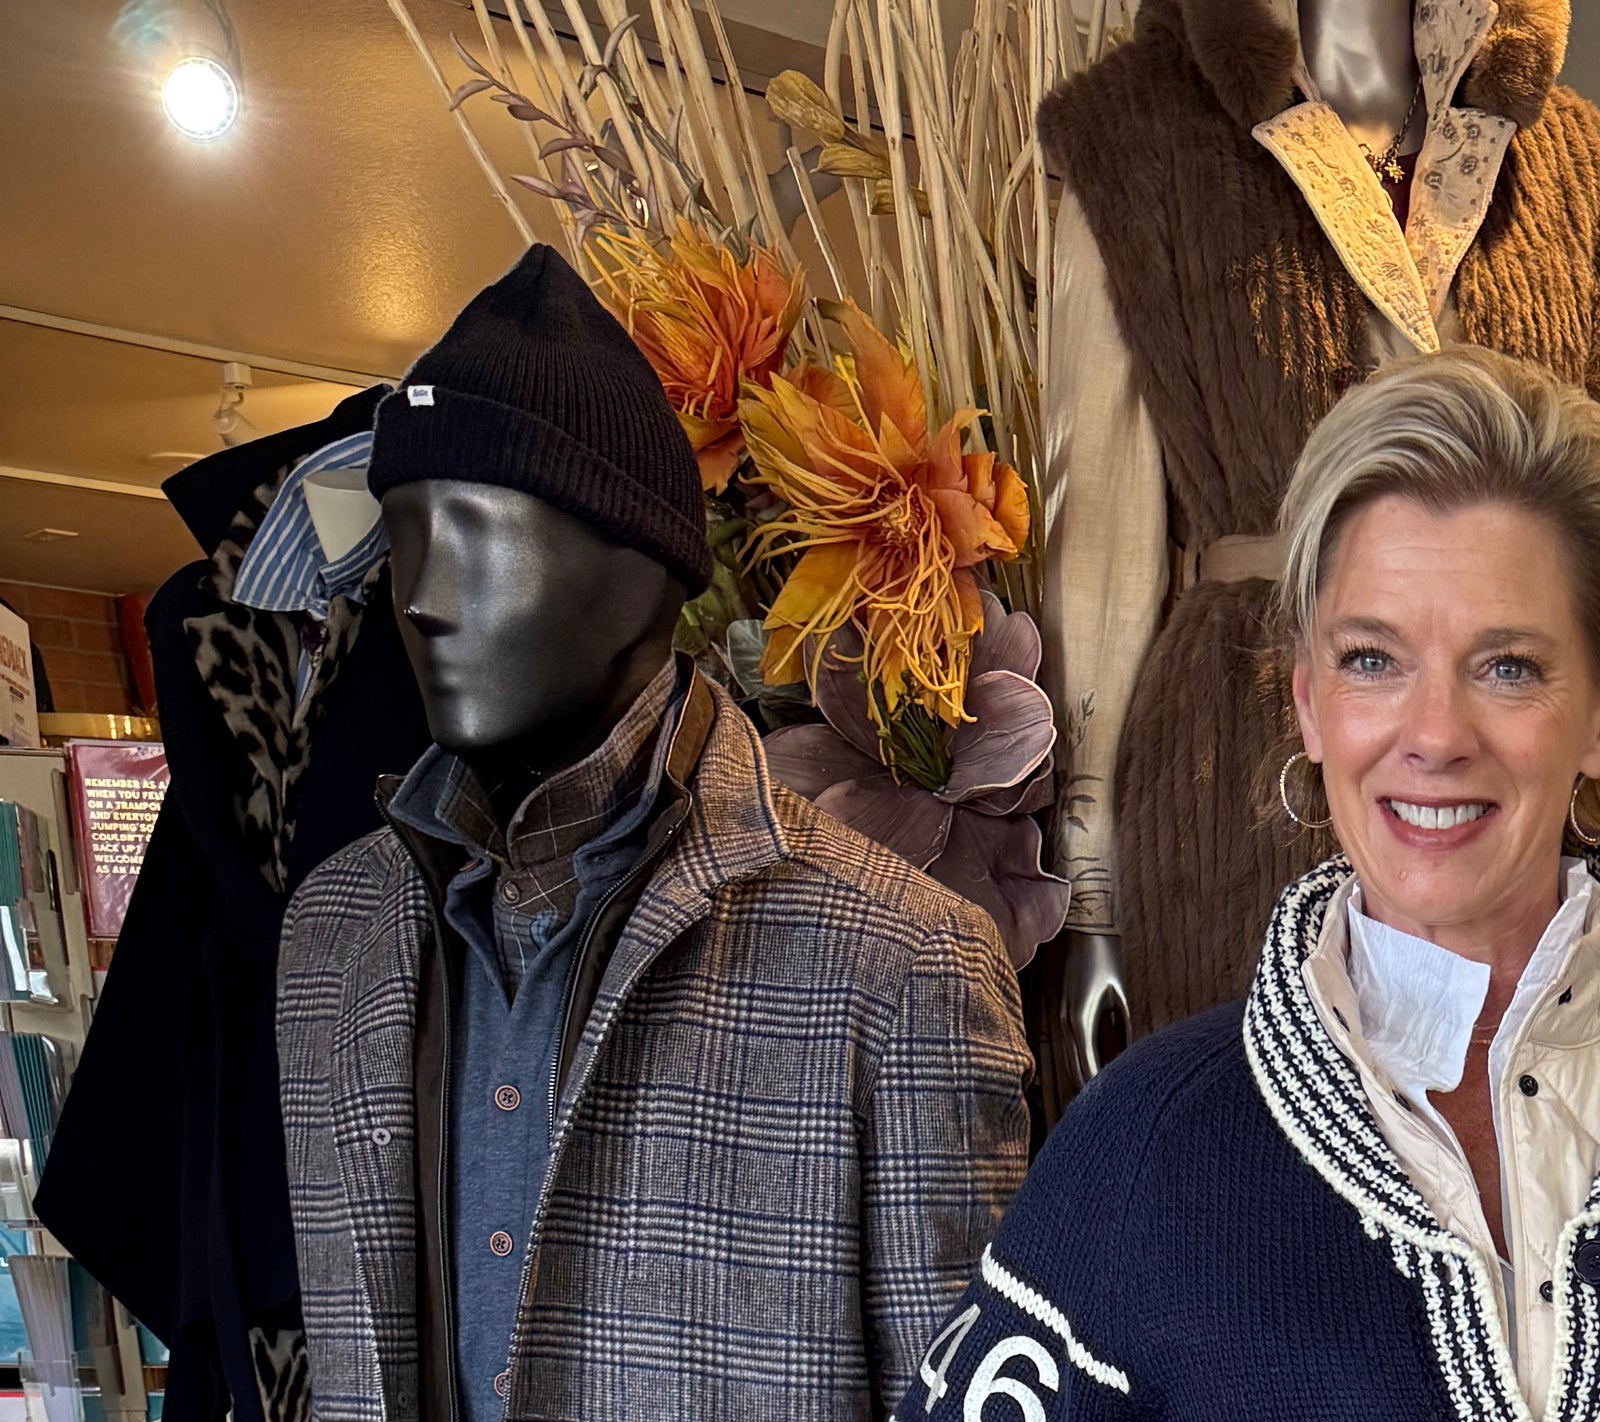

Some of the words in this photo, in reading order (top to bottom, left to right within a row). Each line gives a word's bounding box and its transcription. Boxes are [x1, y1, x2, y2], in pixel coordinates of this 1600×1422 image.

[85, 778, 140, 789] REMEMBER
[143, 780, 156, 789] AS
[87, 790, 116, 798] WHEN
[119, 791, 139, 799] YOU
[88, 801, 103, 809] ON
[91, 823, 138, 831] JUMPING
[140, 824, 154, 832] SO
[92, 844, 119, 852] BACK
[96, 865, 109, 873] AS
